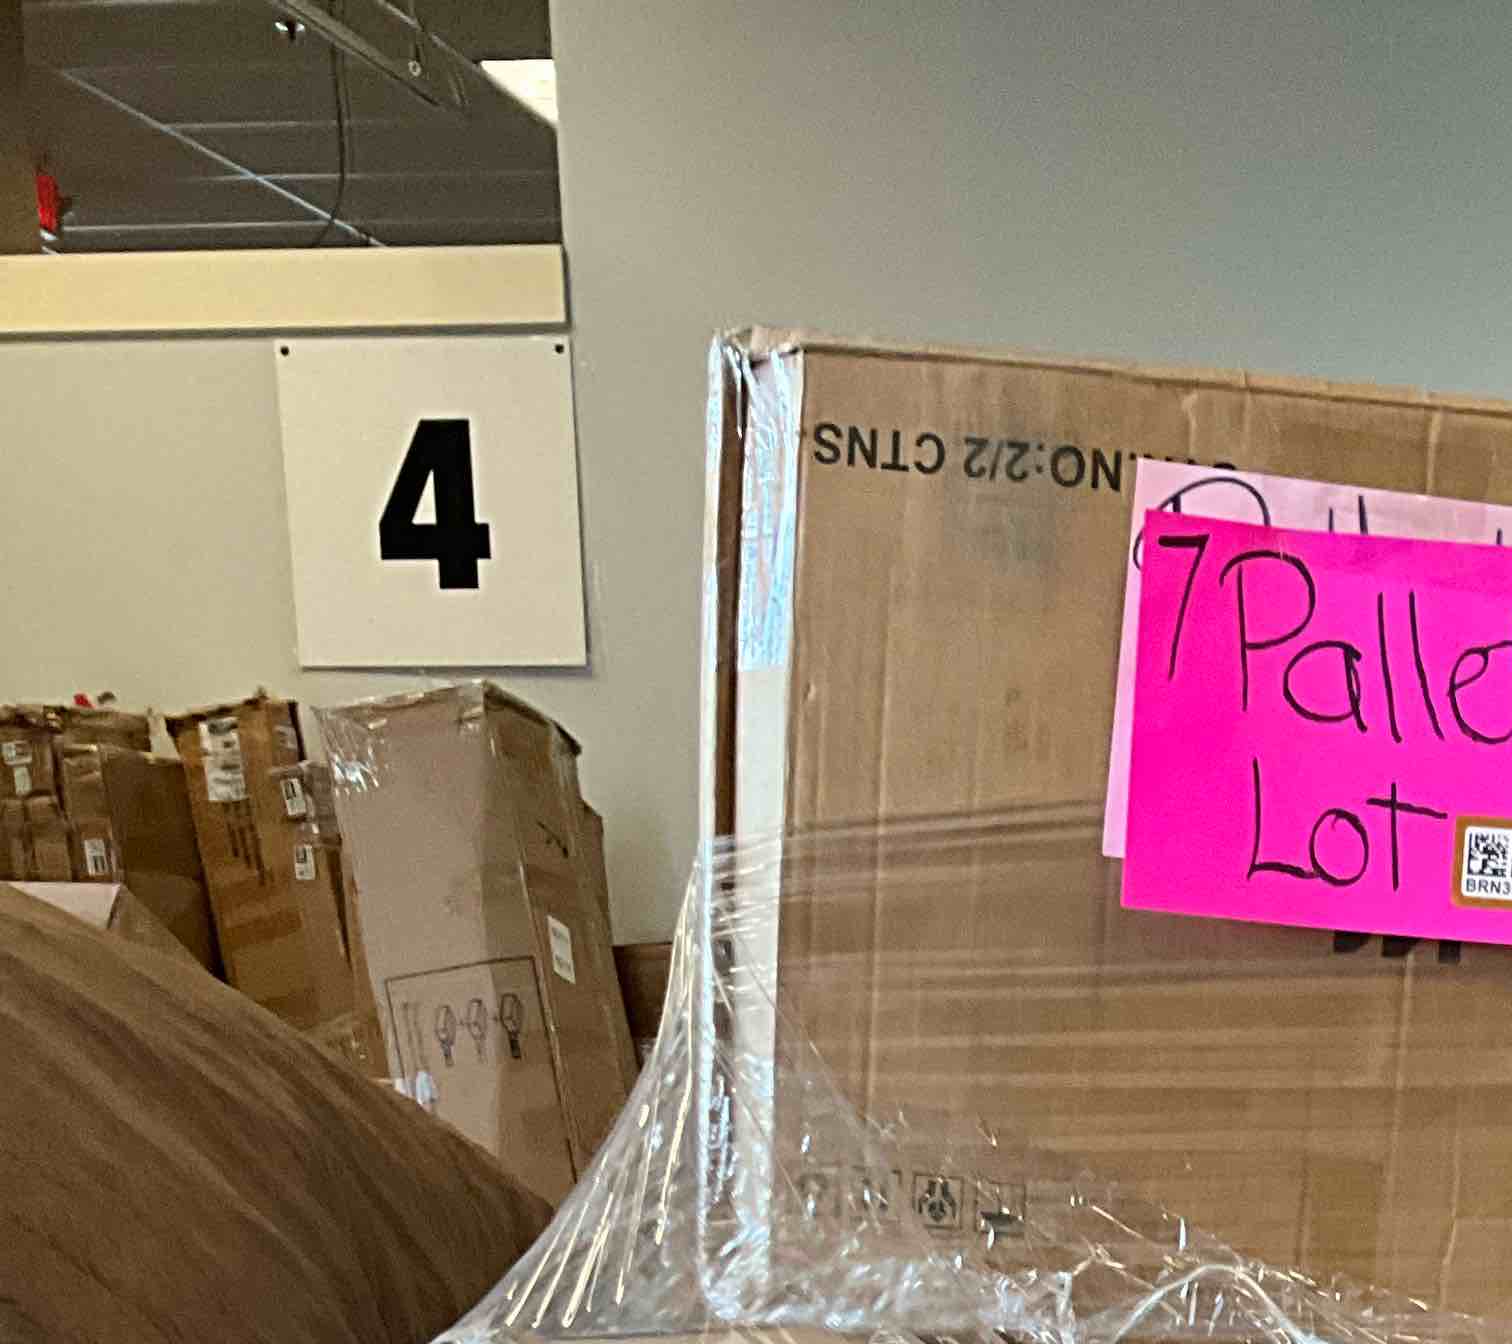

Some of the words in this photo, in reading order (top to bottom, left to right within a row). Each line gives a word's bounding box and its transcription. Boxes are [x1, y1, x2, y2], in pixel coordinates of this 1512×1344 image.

[377, 417, 492, 590] 4
[813, 423, 946, 475] CTNS
[1158, 532, 1211, 682] 7
[1246, 756, 1450, 892] Lot
